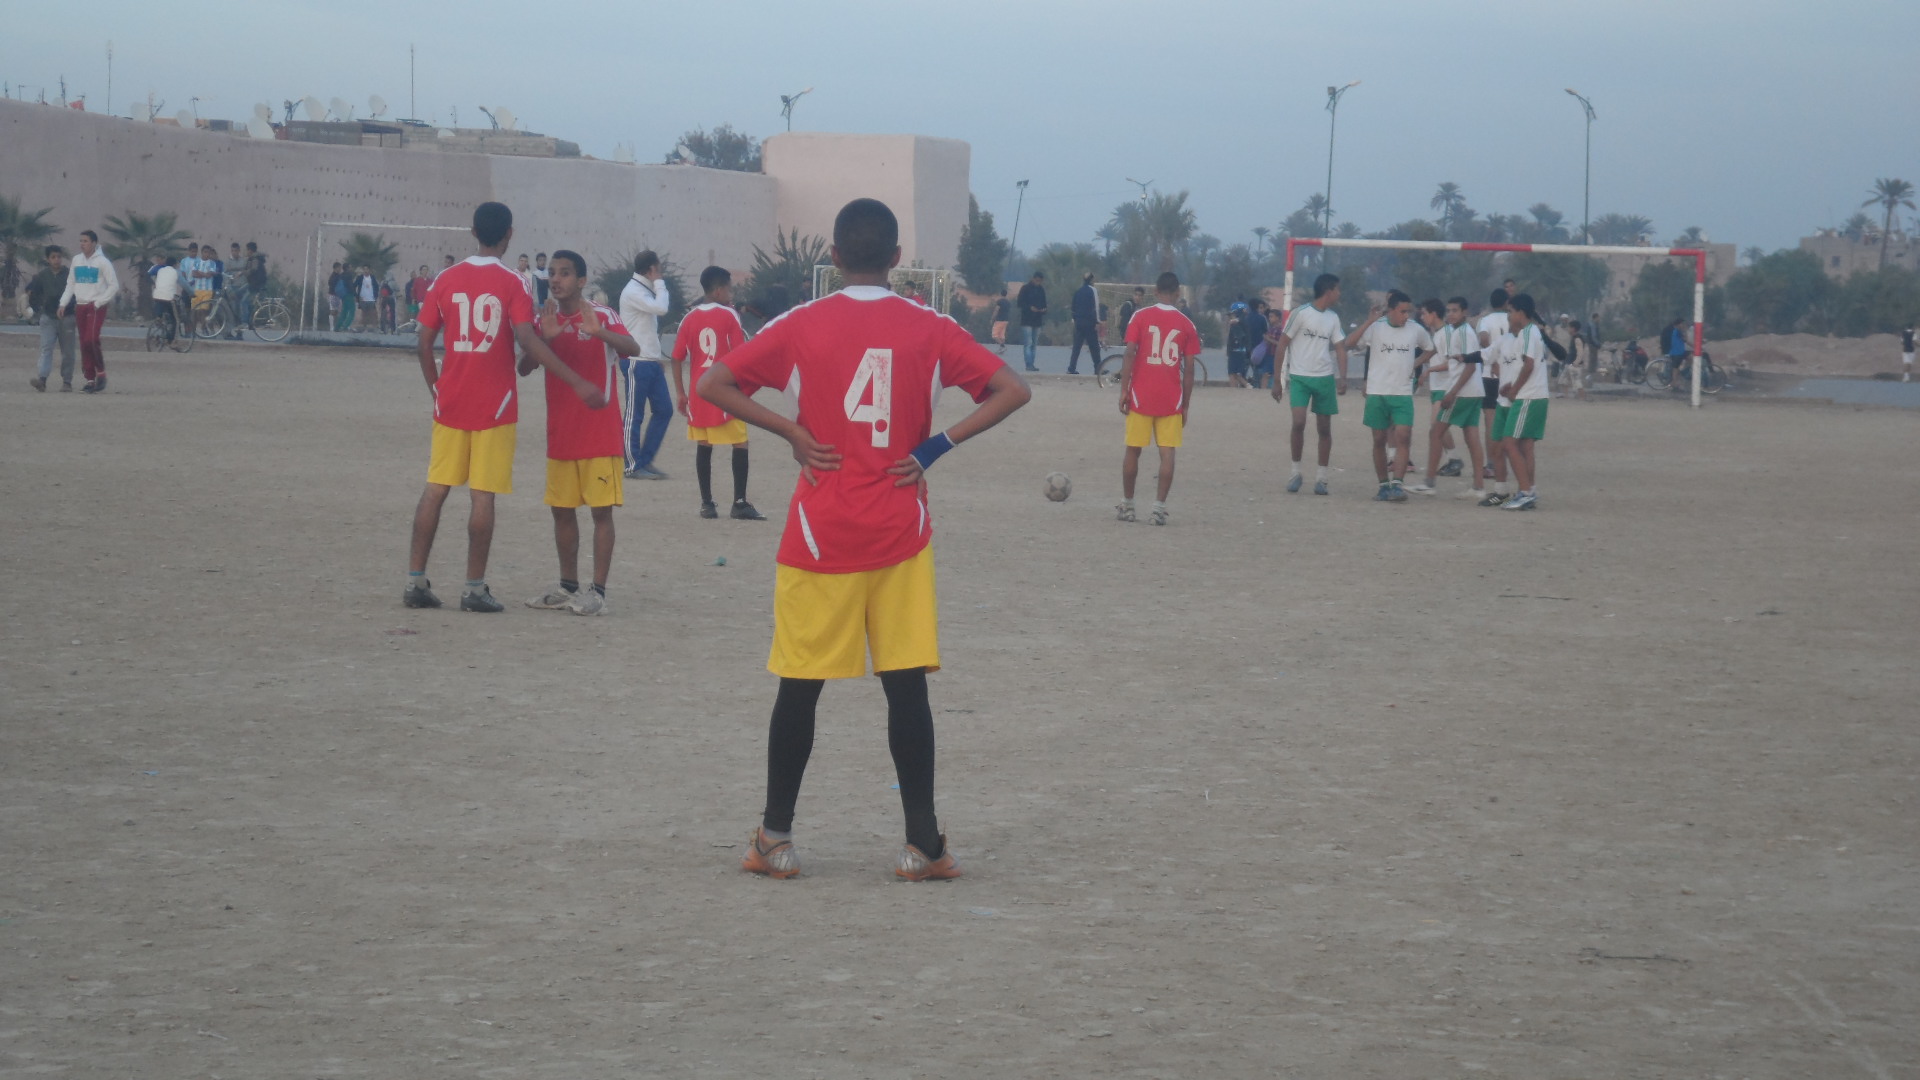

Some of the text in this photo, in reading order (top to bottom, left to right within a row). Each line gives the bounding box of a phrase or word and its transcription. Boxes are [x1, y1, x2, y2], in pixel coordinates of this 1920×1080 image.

[452, 292, 502, 352] 19
[699, 327, 717, 368] 9
[1147, 324, 1180, 366] 16
[843, 347, 893, 448] 4
